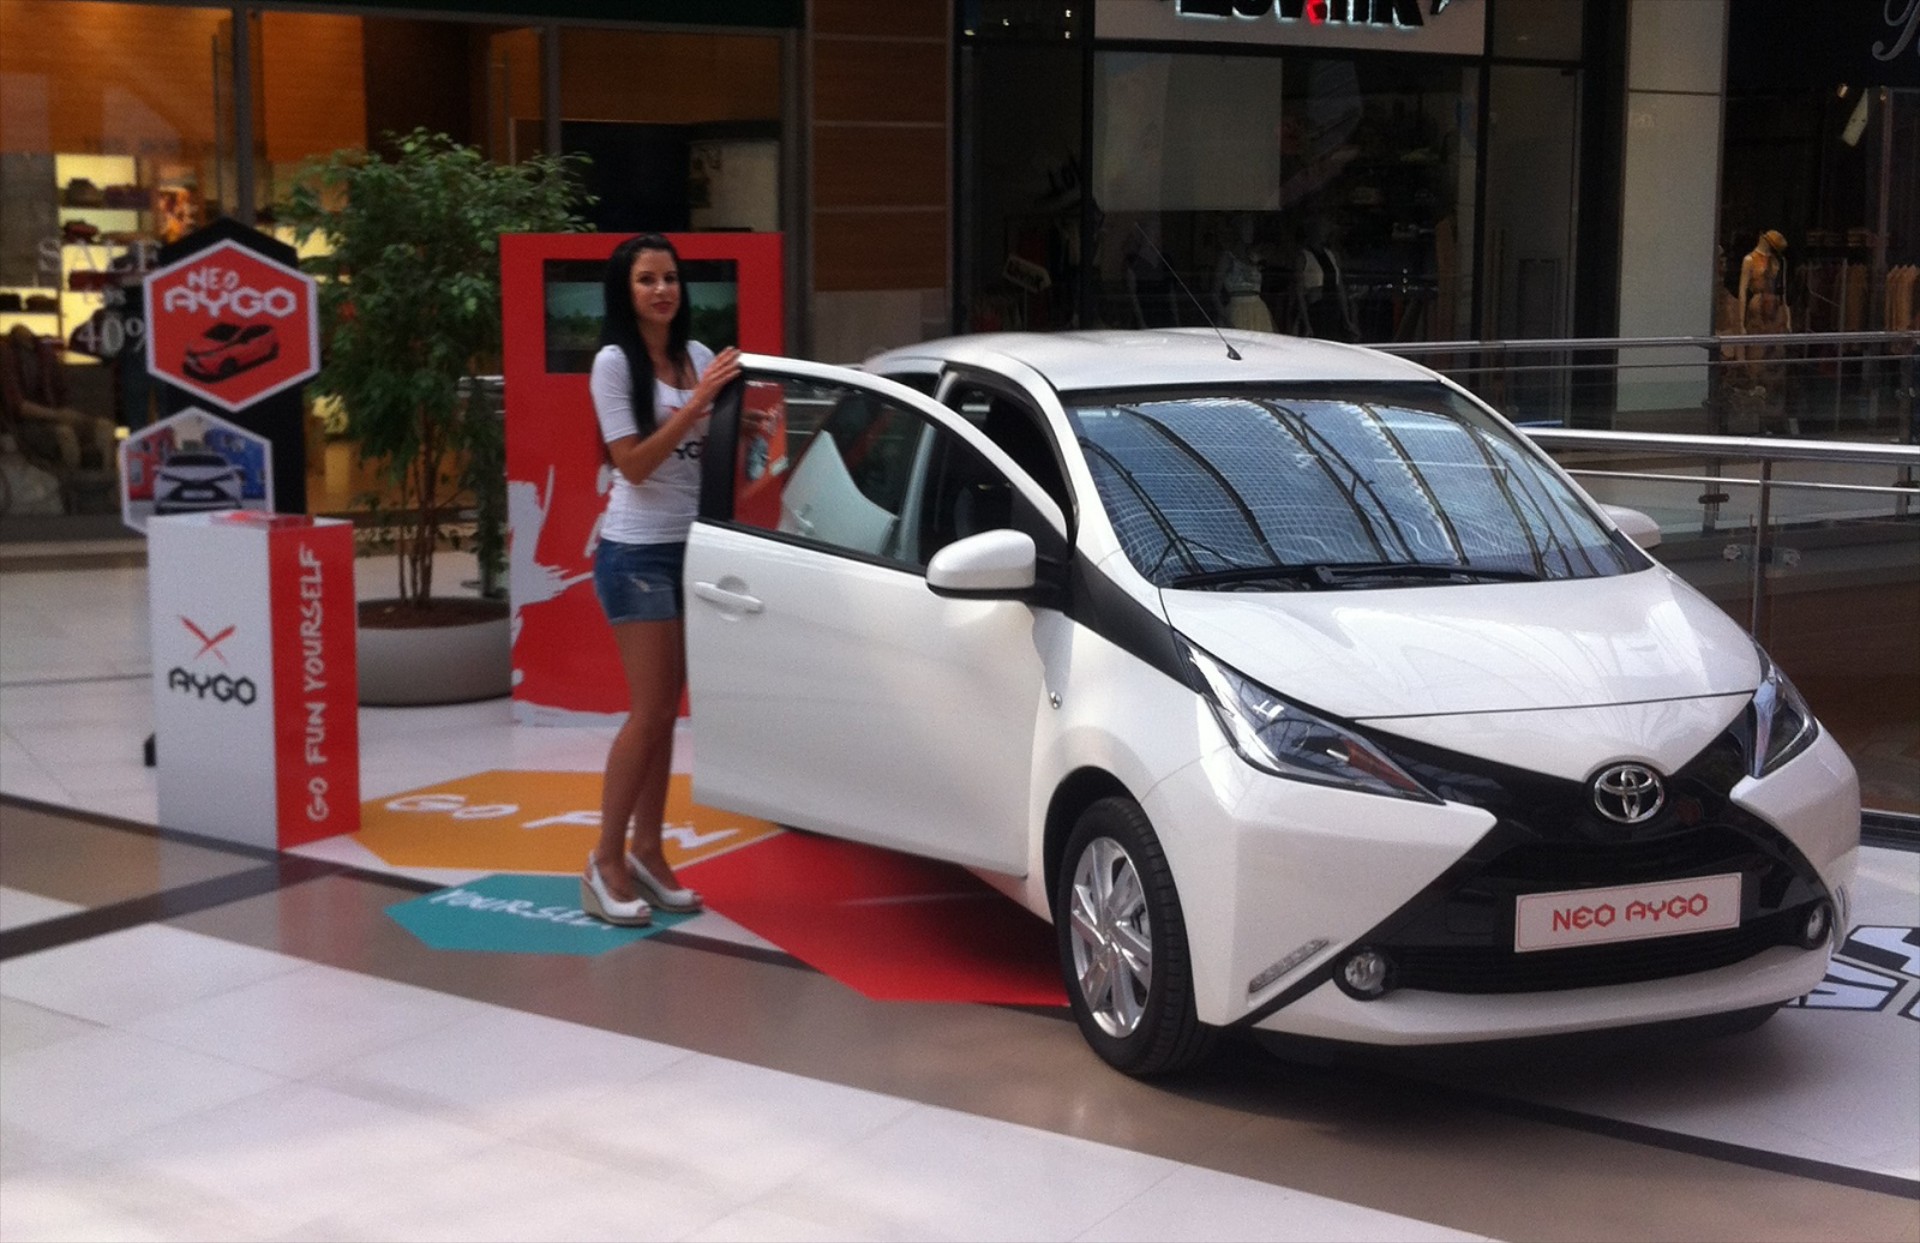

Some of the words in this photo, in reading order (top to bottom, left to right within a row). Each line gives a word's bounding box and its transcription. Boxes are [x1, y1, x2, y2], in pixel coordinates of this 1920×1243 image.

[187, 266, 240, 290] NEO
[164, 286, 297, 318] AYGO
[299, 541, 327, 693] YOURSELF
[169, 666, 256, 706] AYGO
[304, 702, 328, 765] FUN
[306, 777, 329, 821] GO
[384, 793, 519, 820] GO
[521, 810, 740, 849] FN
[1552, 904, 1616, 932] NEO
[1625, 893, 1708, 922] AYGO
